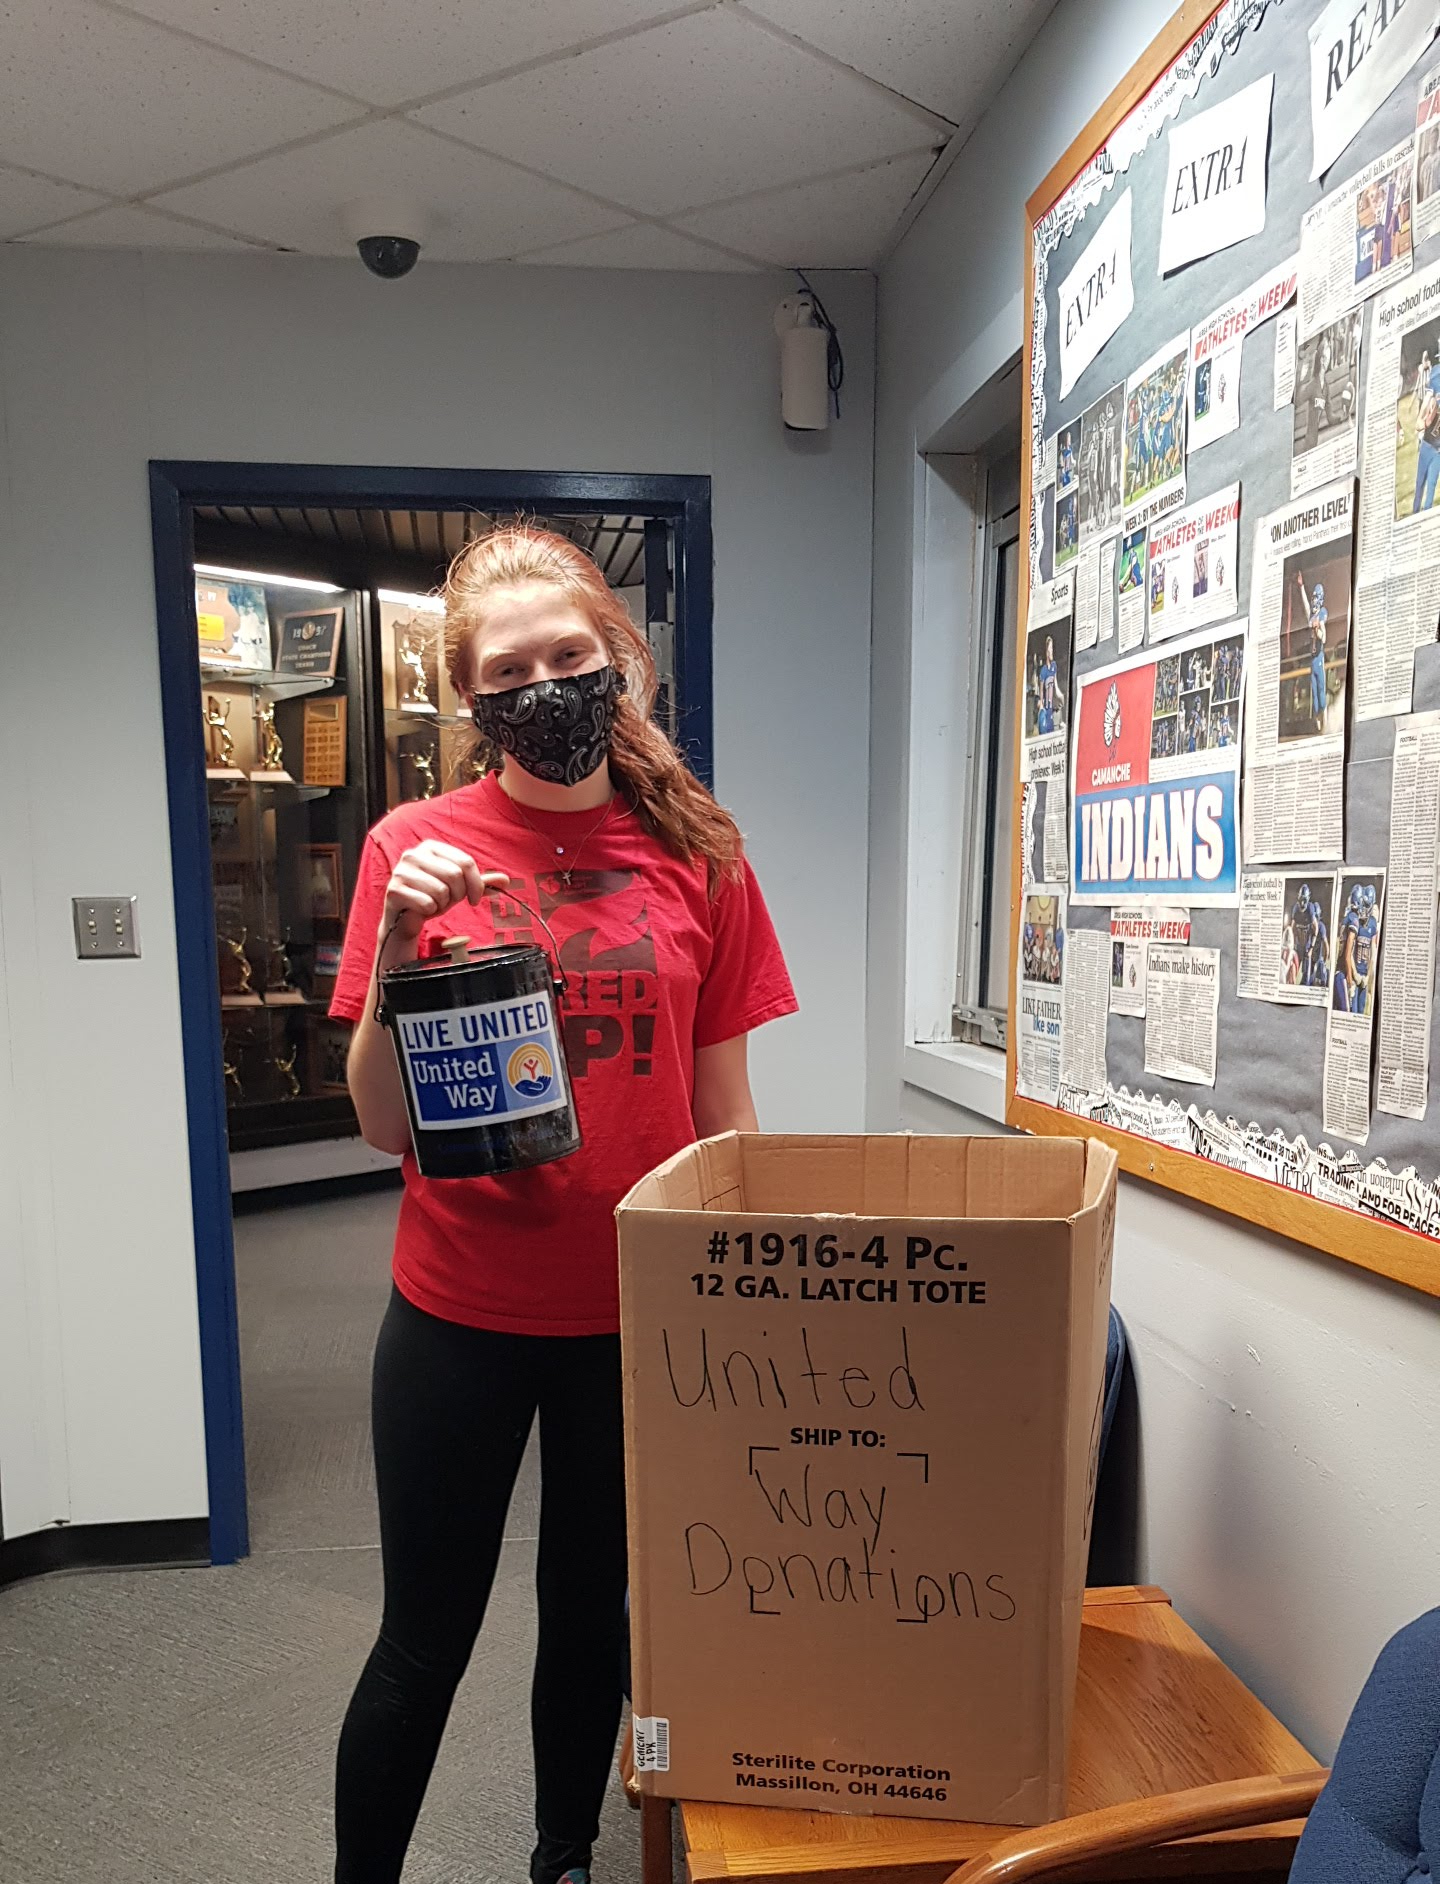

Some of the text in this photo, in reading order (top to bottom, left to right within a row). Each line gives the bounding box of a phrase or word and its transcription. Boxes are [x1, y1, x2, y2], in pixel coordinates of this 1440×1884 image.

[1172, 136, 1248, 215] EXTRA
[1066, 248, 1117, 349] EXTRA
[1379, 304, 1396, 328] High
[1397, 288, 1421, 317] school
[1200, 307, 1249, 358] ATHLETES
[1258, 278, 1292, 317] WEEK
[1125, 509, 1137, 533] WEEK
[1143, 506, 1149, 523] BY
[1149, 501, 1158, 517] THE
[1158, 486, 1185, 513] NUMBERS
[1283, 507, 1320, 538] ANOTHER
[1156, 520, 1197, 556] ATHLETES
[1205, 502, 1236, 533] WEEK
[1051, 584, 1069, 605] Sports
[1029, 746, 1037, 763] High
[1038, 744, 1052, 760] school
[1051, 760, 1061, 777] Week
[1091, 762, 1131, 787] CAMANCHE
[1081, 784, 1224, 882] INDIANS
[1263, 877, 1277, 889] football
[1115, 921, 1152, 938] ATHLETES
[1152, 921, 1158, 930] OF
[1160, 922, 1184, 940] WEEK
[1149, 955, 1216, 982] Indians make history
[1022, 996, 1036, 1016] LIKE
[403, 1001, 548, 1049] LIVE UNITED
[1046, 1021, 1060, 1036] son
[564, 1014, 656, 1078] P!
[413, 1052, 495, 1084] United
[446, 1084, 497, 1111] Way
[1318, 1162, 1355, 1190] TRADING
[1382, 1197, 1401, 1220] FOR
[707, 1231, 889, 1269] #1916-4
[690, 1274, 986, 1304] 12 GA. LATCH TOTE
[663, 1326, 926, 1411] United
[790, 1428, 886, 1448] SHIP TO:
[755, 1464, 886, 1556] Way
[685, 1522, 1016, 1621] Donations
[732, 1752, 951, 1782] Sterilite Corporation
[736, 1772, 948, 1802] Massillon, OH 44646
